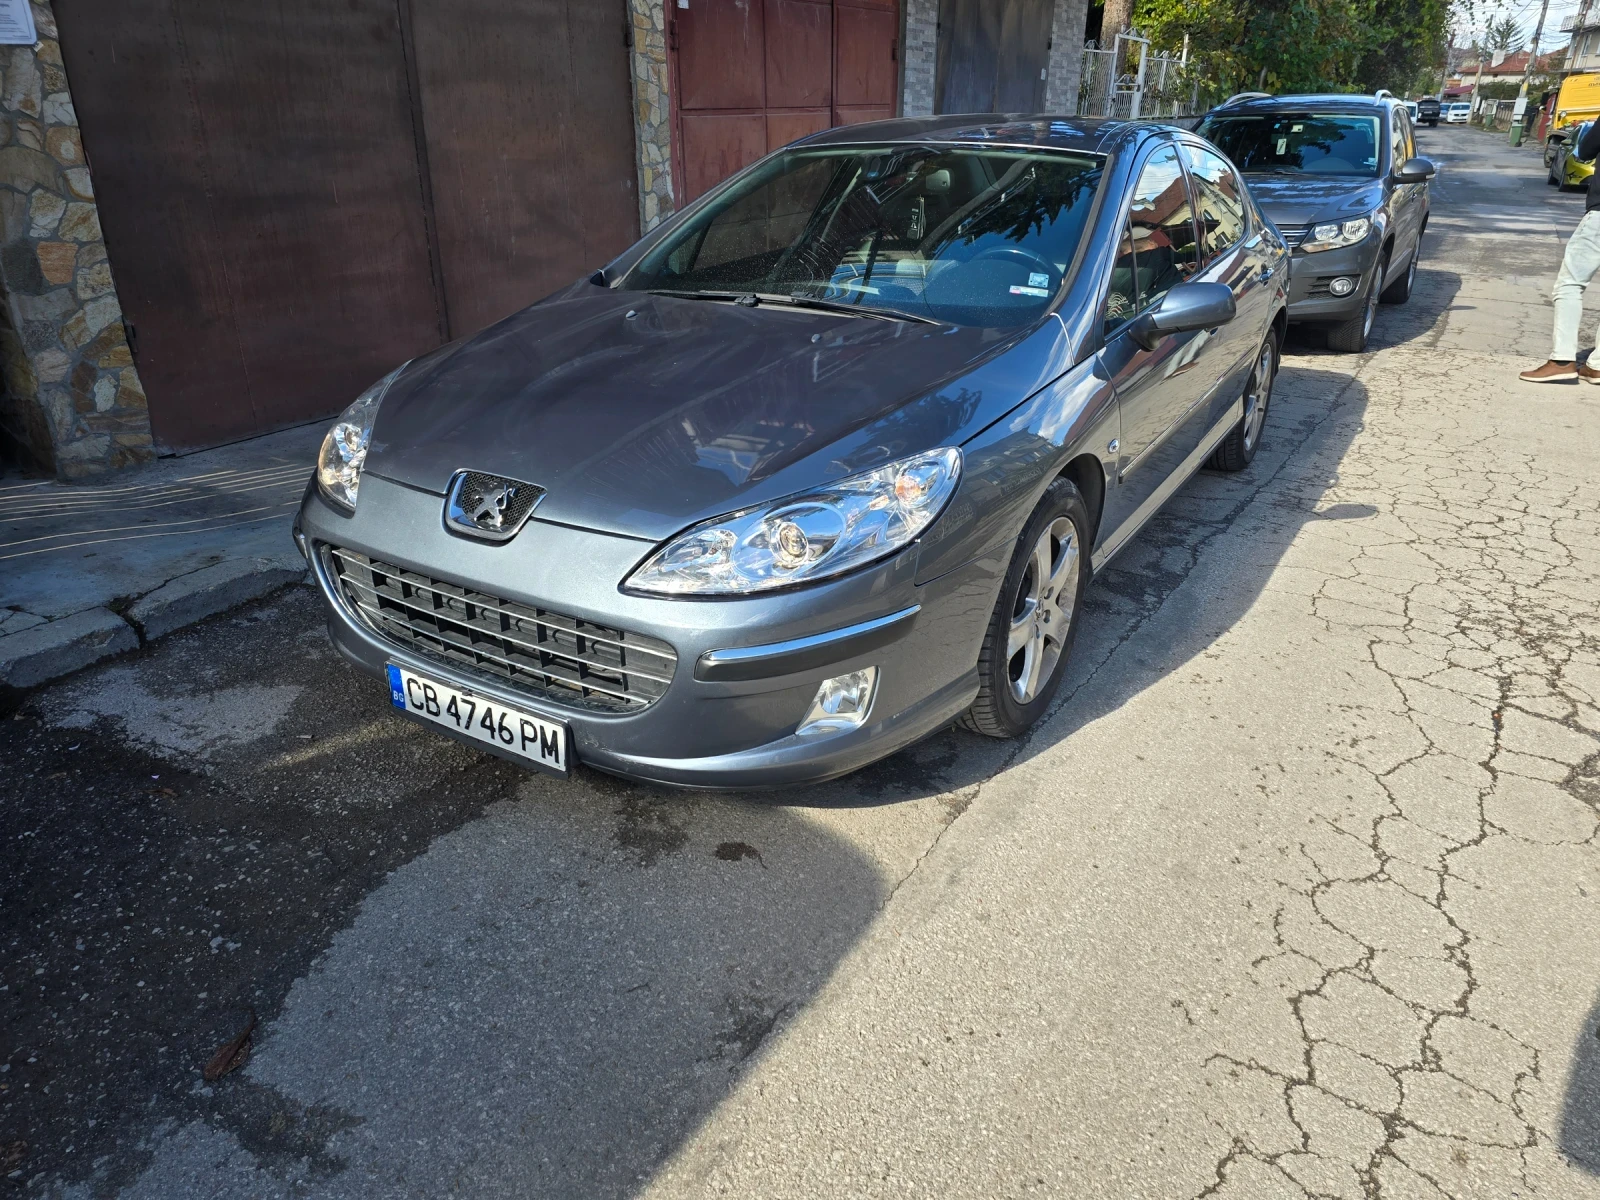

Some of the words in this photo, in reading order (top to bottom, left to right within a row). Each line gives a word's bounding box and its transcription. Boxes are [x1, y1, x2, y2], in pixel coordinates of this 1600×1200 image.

[393, 690, 404, 702] BG
[407, 677, 440, 717] CB
[446, 694, 514, 745] 4746
[520, 718, 560, 764] PM
